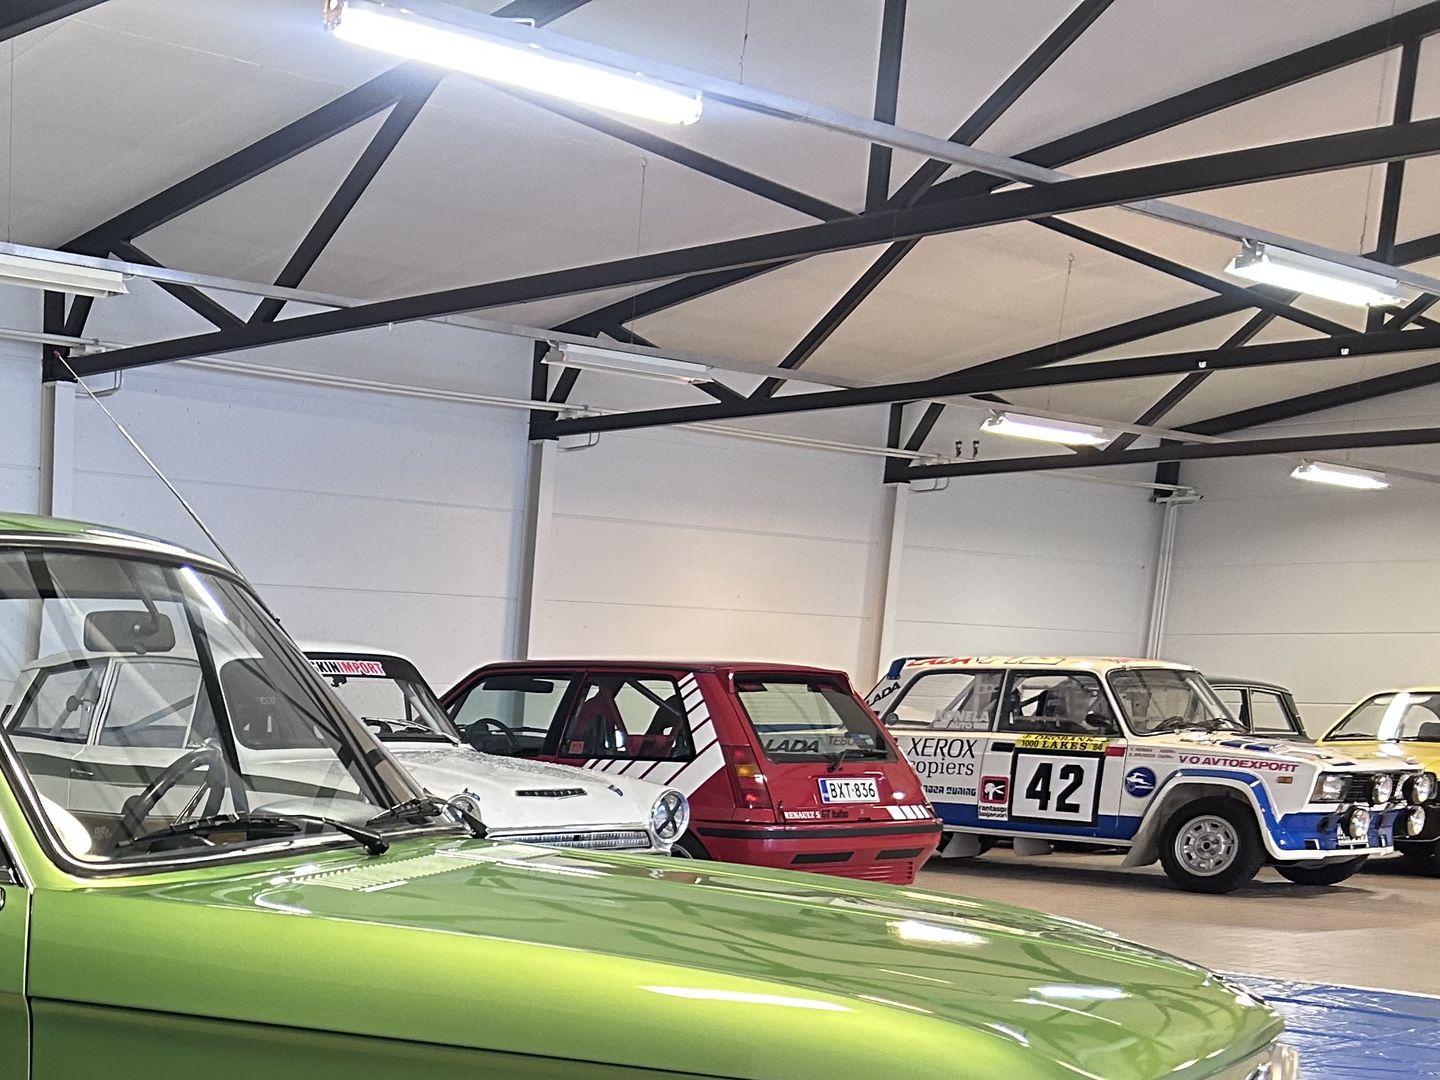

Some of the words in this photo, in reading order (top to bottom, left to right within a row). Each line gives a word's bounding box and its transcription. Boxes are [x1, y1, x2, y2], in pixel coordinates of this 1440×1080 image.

[312, 661, 385, 674] KINIMPORT
[765, 739, 819, 753] LADA
[907, 737, 978, 759] XEROX
[1021, 739, 1039, 748] 1000
[1042, 740, 1088, 750] LAKES
[1202, 757, 1300, 773] AVTOEXPORT
[829, 782, 876, 799] BXT-836
[1025, 762, 1085, 814] 42
